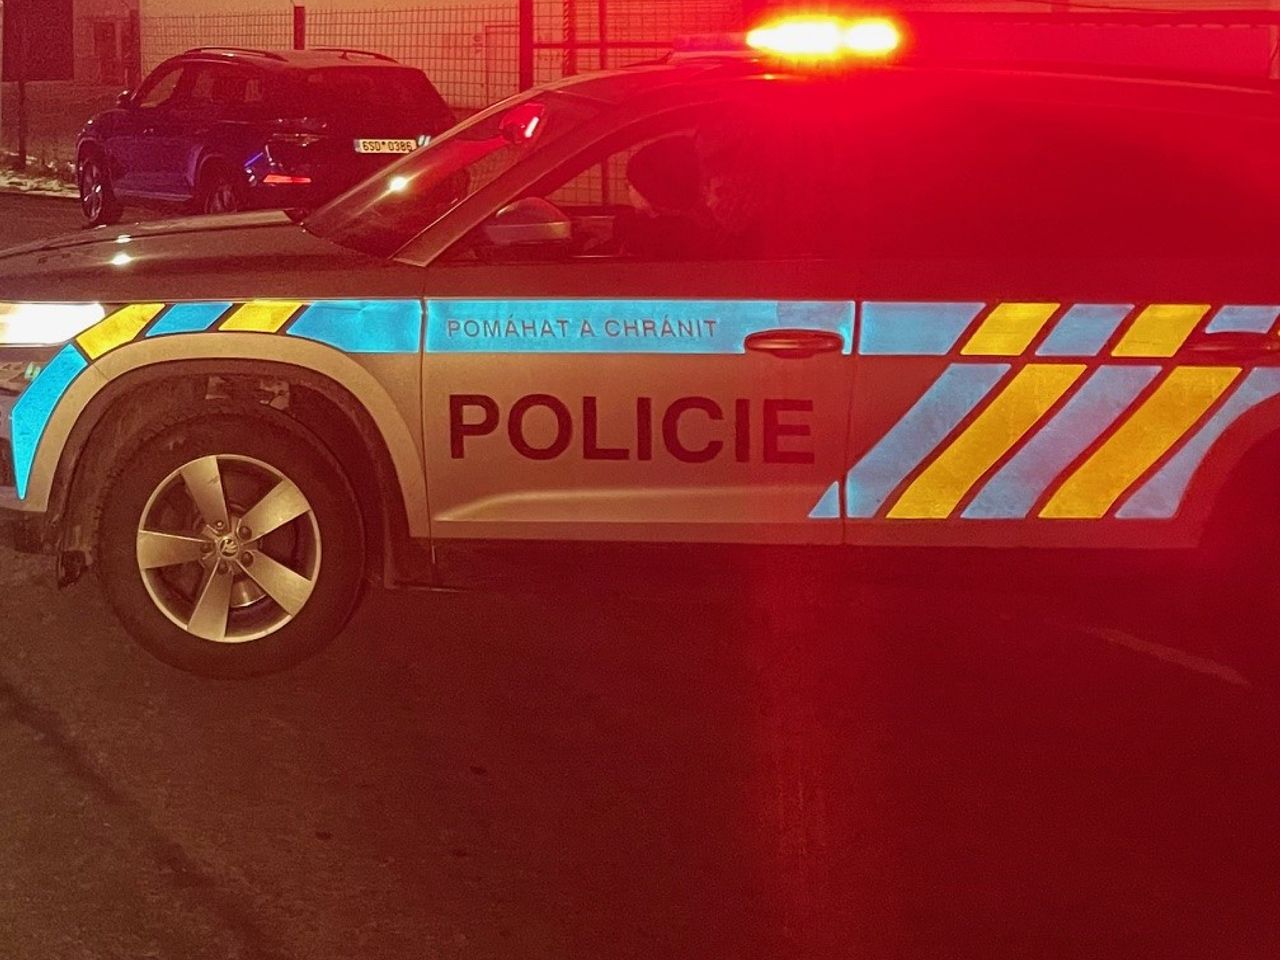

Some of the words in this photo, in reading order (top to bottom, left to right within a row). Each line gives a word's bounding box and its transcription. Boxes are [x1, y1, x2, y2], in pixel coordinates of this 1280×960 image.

[447, 314, 569, 338] POMÁHAT
[579, 319, 598, 338] A
[604, 314, 717, 338] CHRÁNIT
[449, 393, 815, 465] POLICIE
